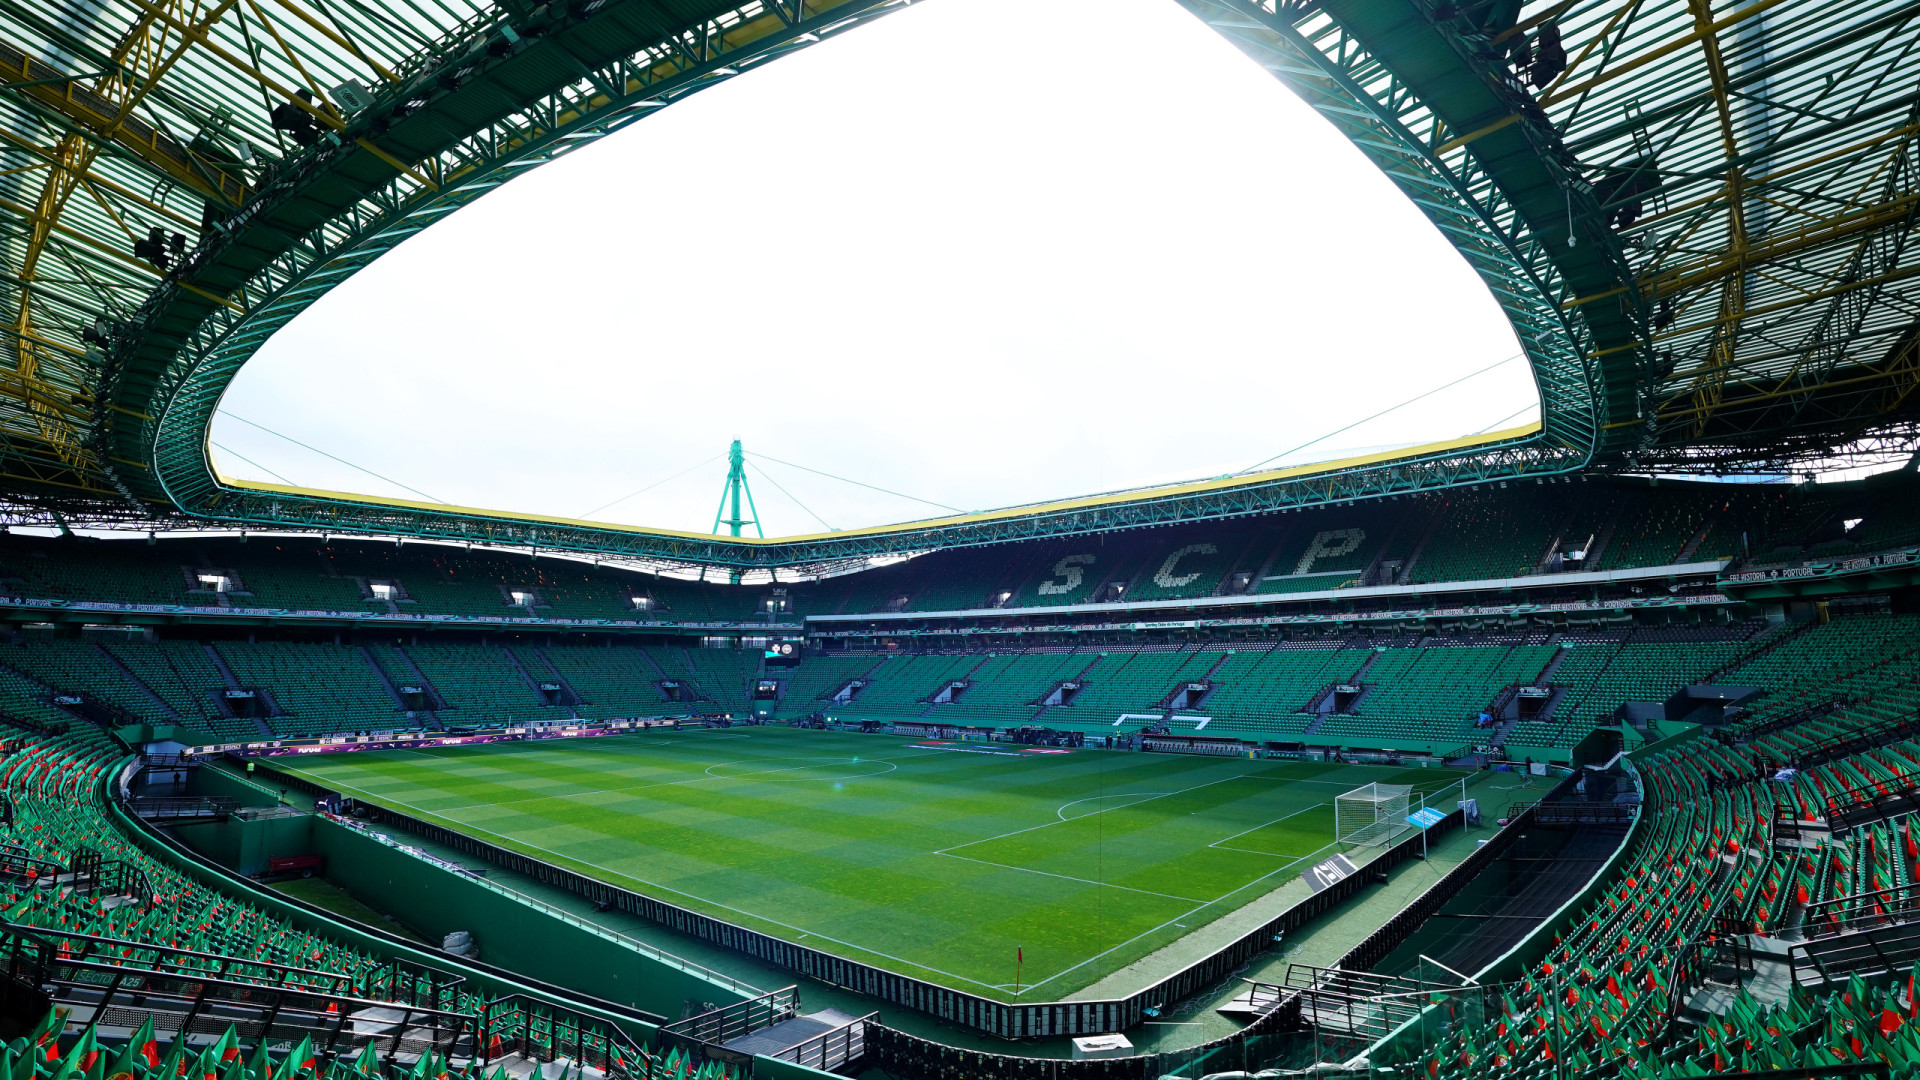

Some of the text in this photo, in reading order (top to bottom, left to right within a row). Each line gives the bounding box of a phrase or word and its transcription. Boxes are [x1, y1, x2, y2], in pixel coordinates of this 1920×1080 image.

[1038, 528, 1366, 595] S C P
[1729, 574, 1739, 582] FAZ
[1782, 567, 1815, 578] PORTUGAL
[1604, 600, 1633, 608] PORTUGAL
[1685, 596, 1696, 604] FAZ
[118, 977, 141, 987] A25
